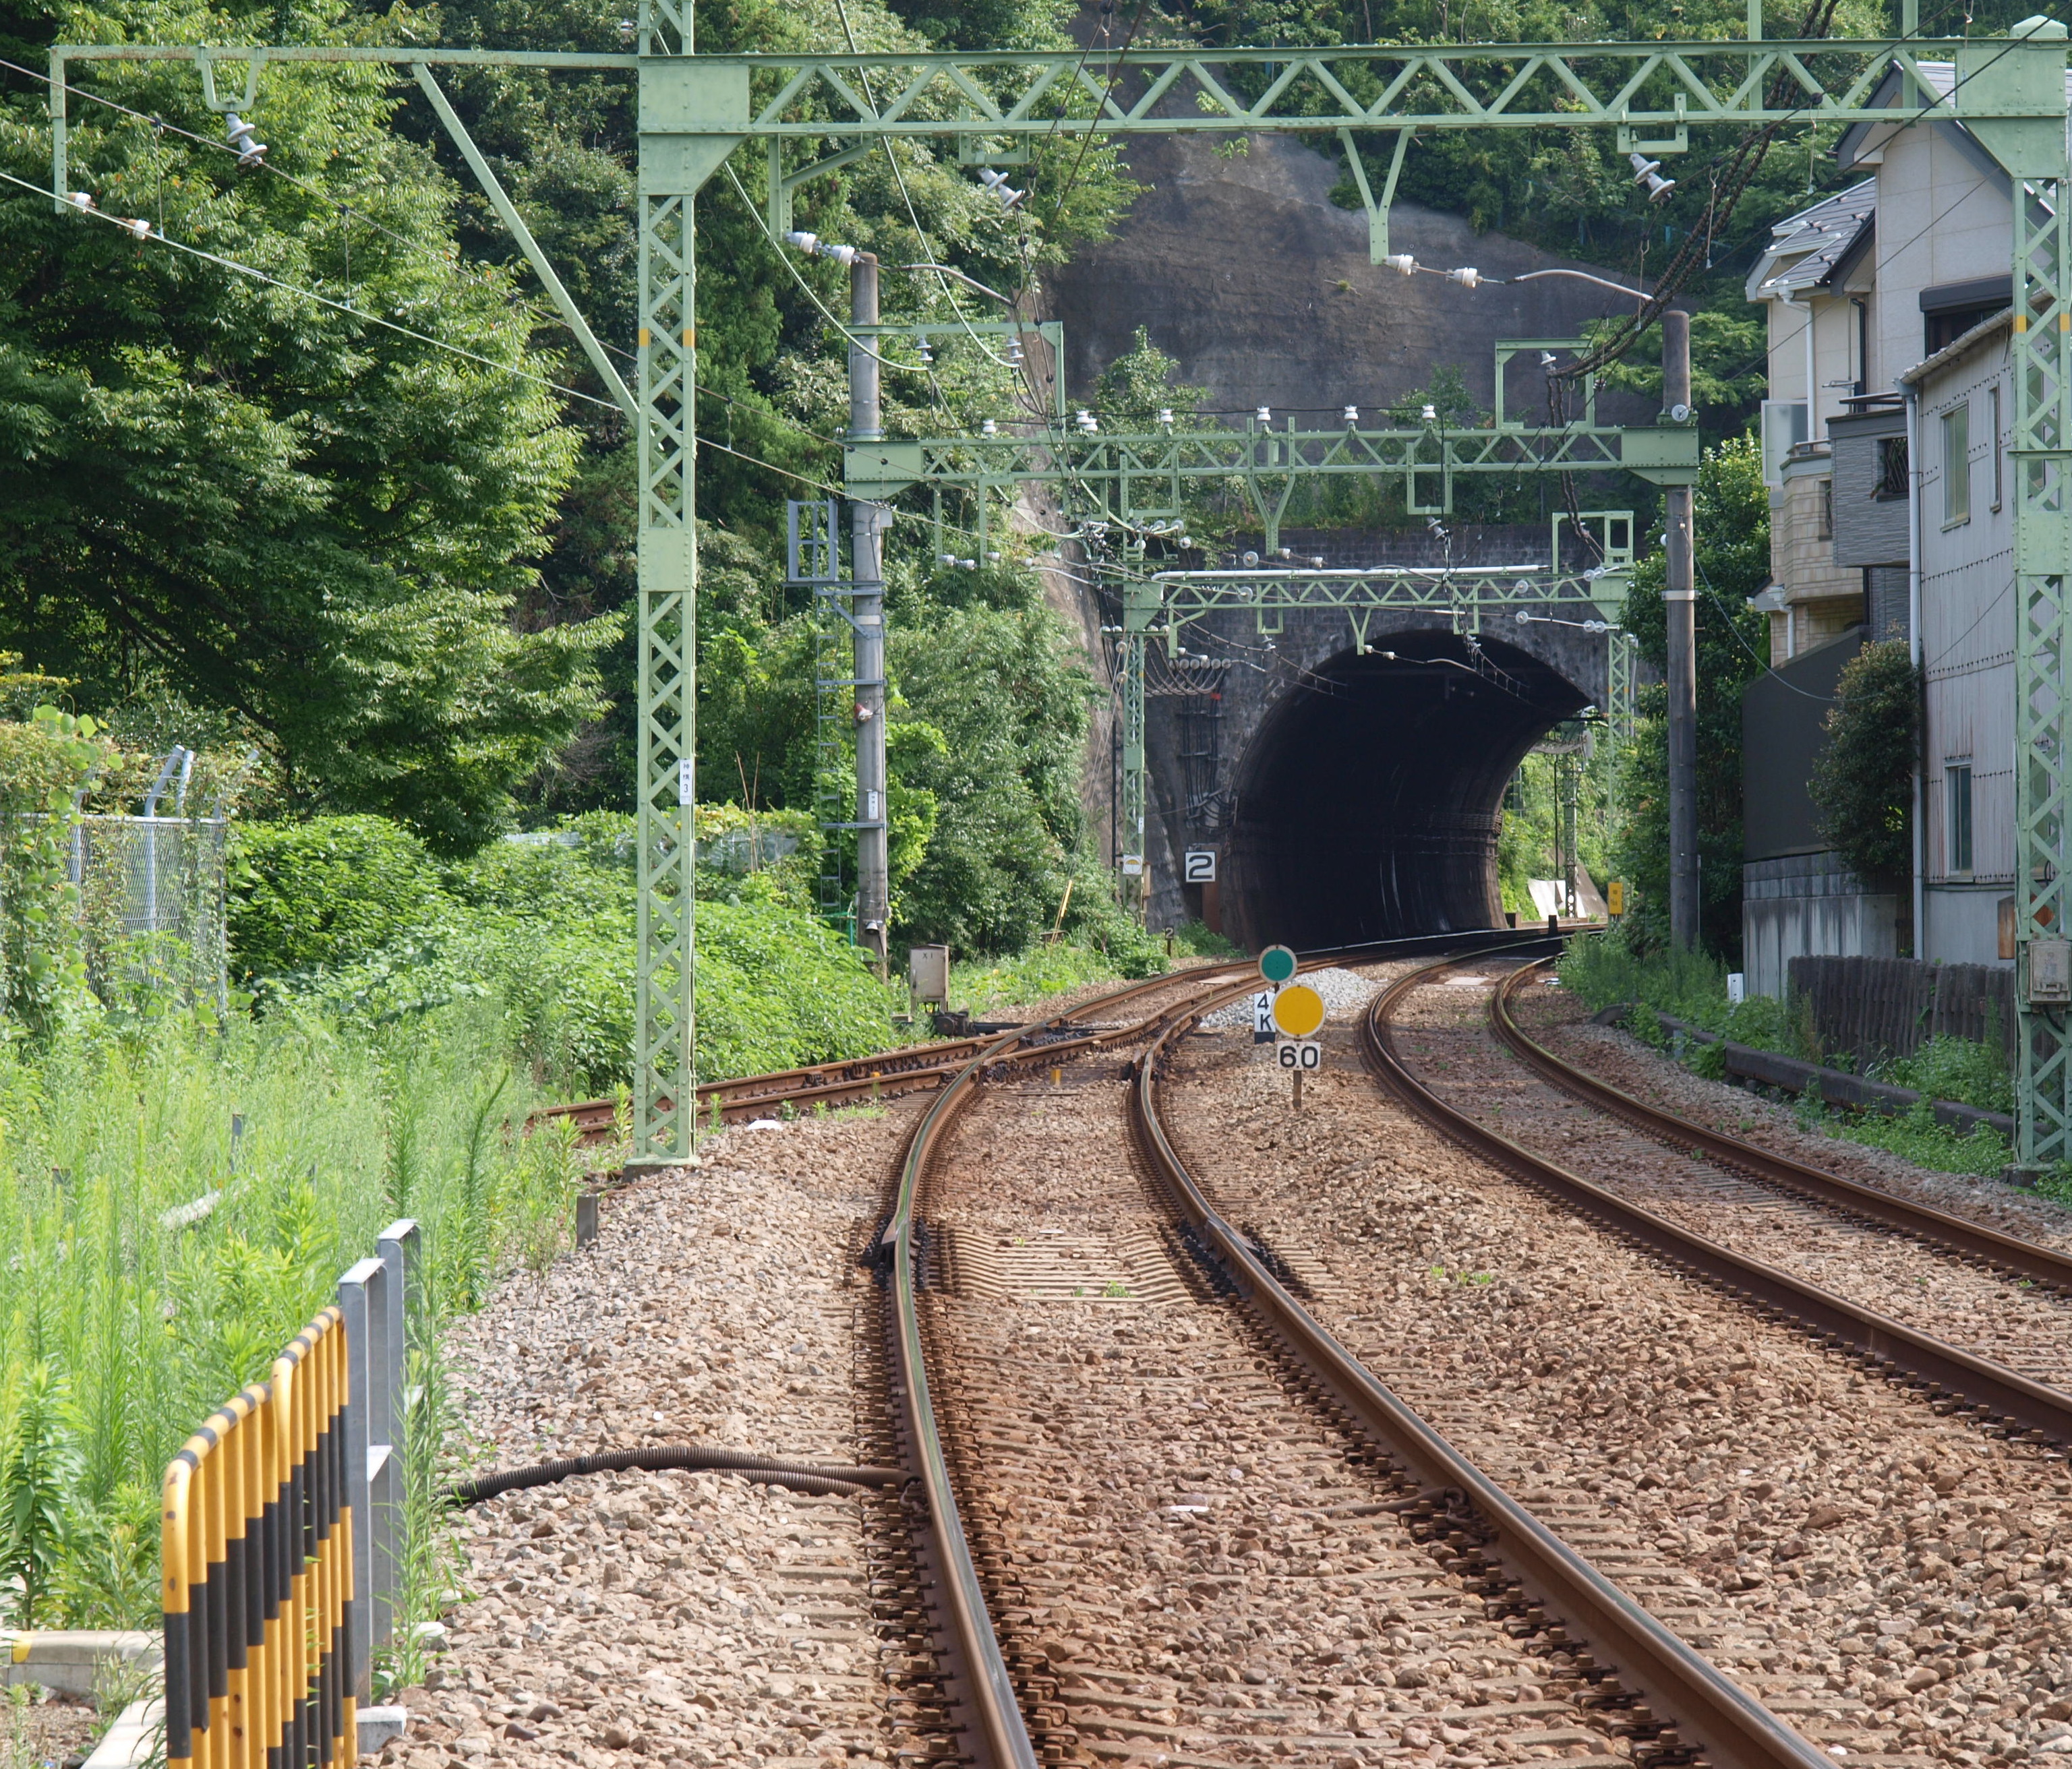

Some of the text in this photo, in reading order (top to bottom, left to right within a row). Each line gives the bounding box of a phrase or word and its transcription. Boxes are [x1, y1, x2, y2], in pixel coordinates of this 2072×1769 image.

[1189, 855, 1212, 879] 2
[1165, 927, 1173, 939] 2
[1280, 1046, 1318, 1069] 60
